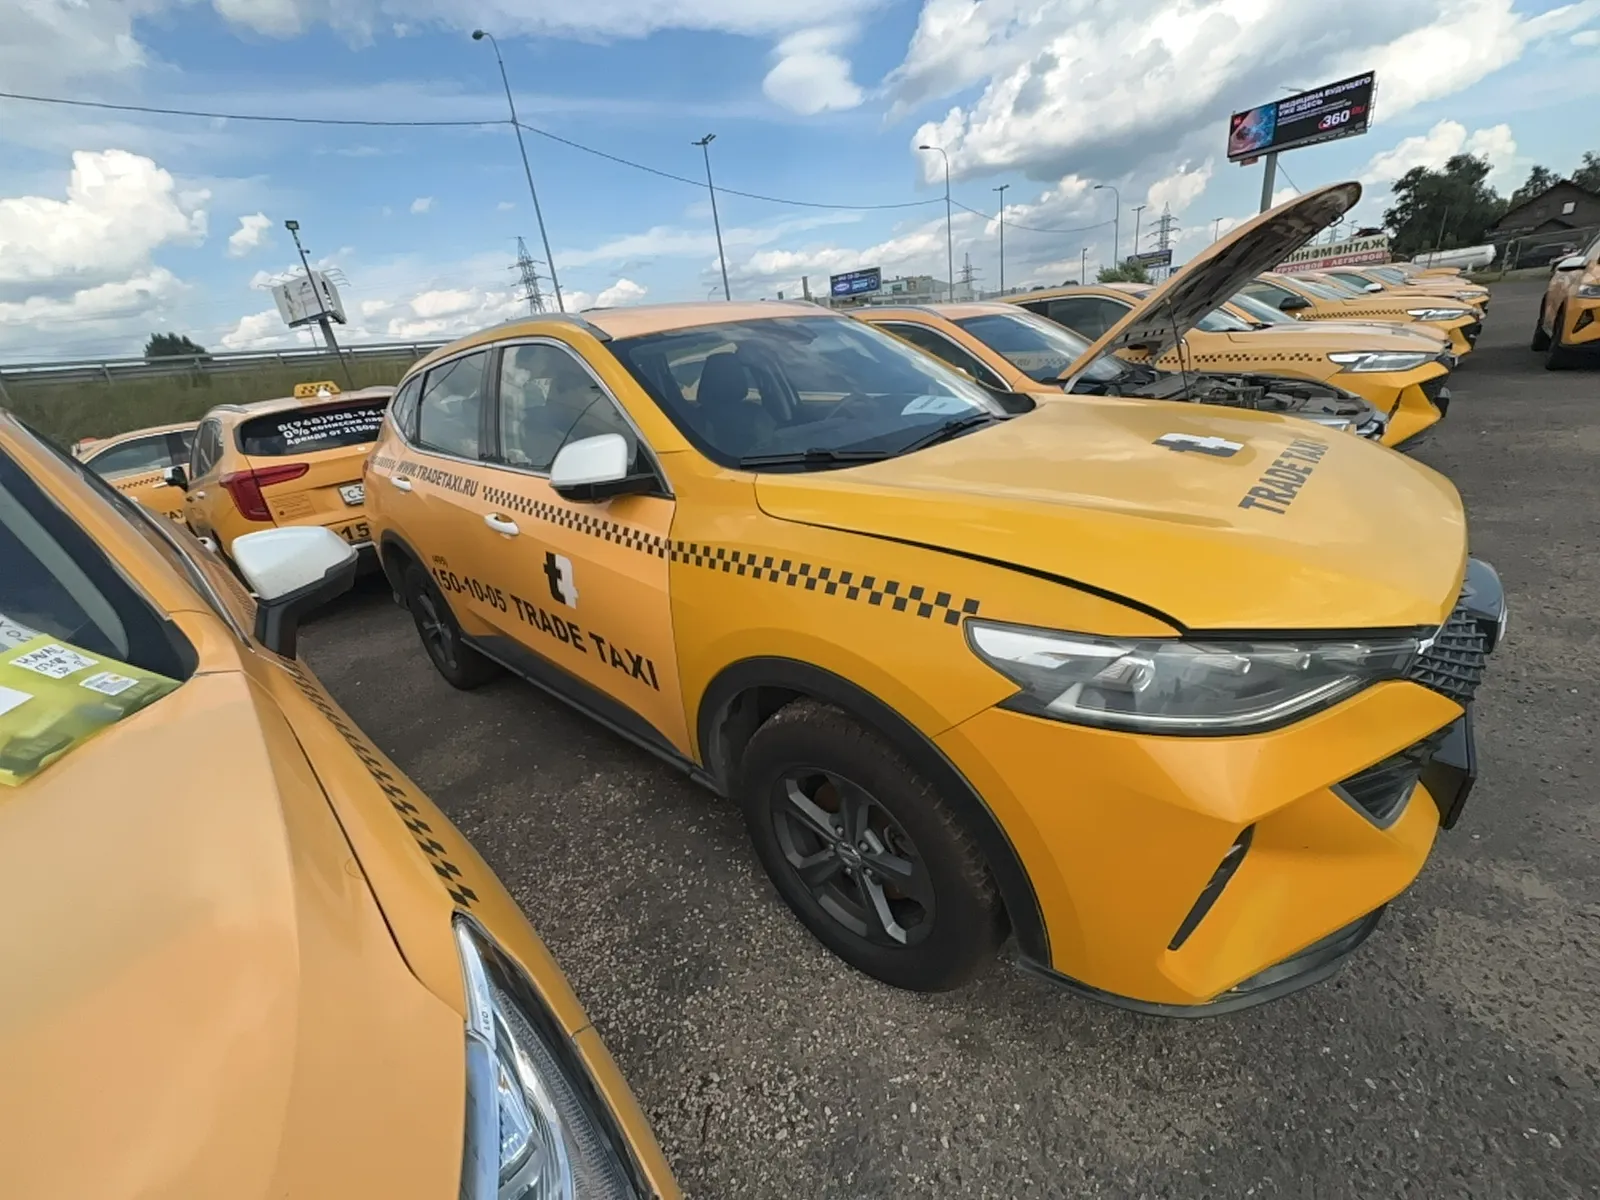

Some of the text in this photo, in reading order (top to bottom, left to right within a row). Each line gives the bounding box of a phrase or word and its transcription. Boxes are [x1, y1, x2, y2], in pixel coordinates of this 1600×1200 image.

[1321, 109, 1350, 128] 360
[329, 429, 341, 437] от
[1237, 438, 1330, 515] TRADE TAXI
[432, 567, 507, 613] 150-10-05
[509, 593, 661, 693] TRADE TAXI
